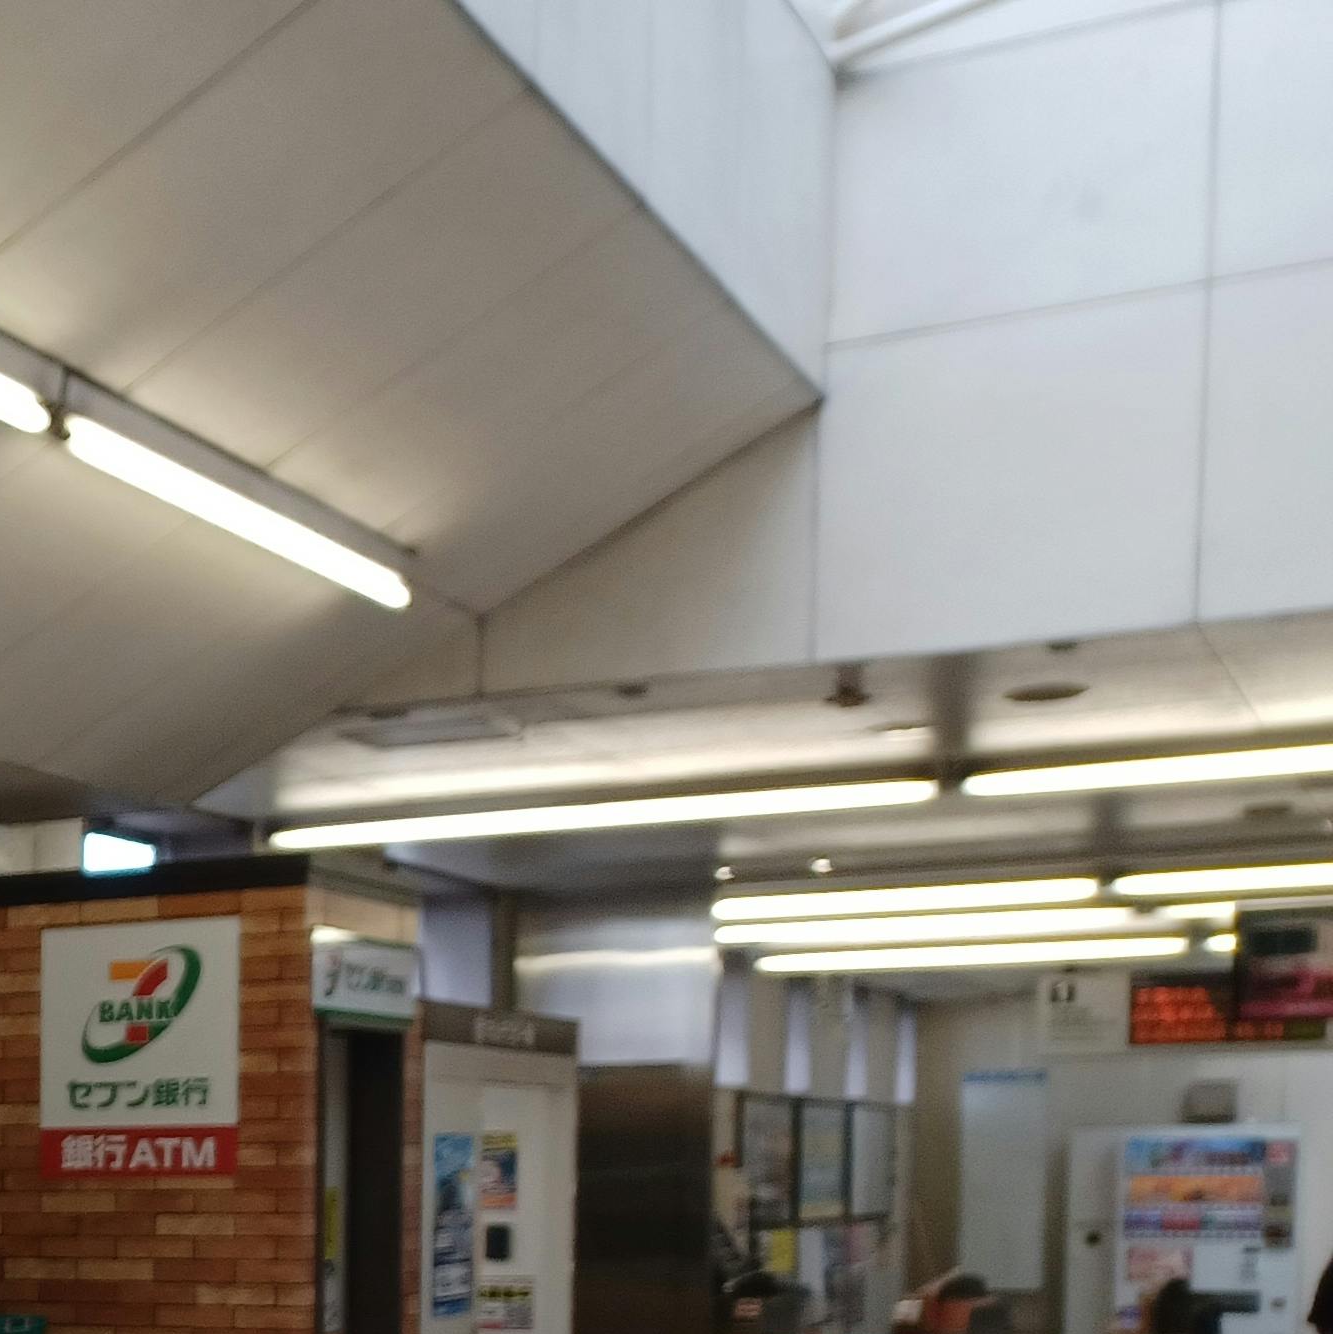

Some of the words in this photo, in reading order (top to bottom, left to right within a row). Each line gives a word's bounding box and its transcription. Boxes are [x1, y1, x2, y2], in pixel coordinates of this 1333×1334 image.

[99, 999, 179, 1022] BANK
[68, 1077, 211, 1110] セブン銀行
[60, 1134, 217, 1170] 銀行ATM
